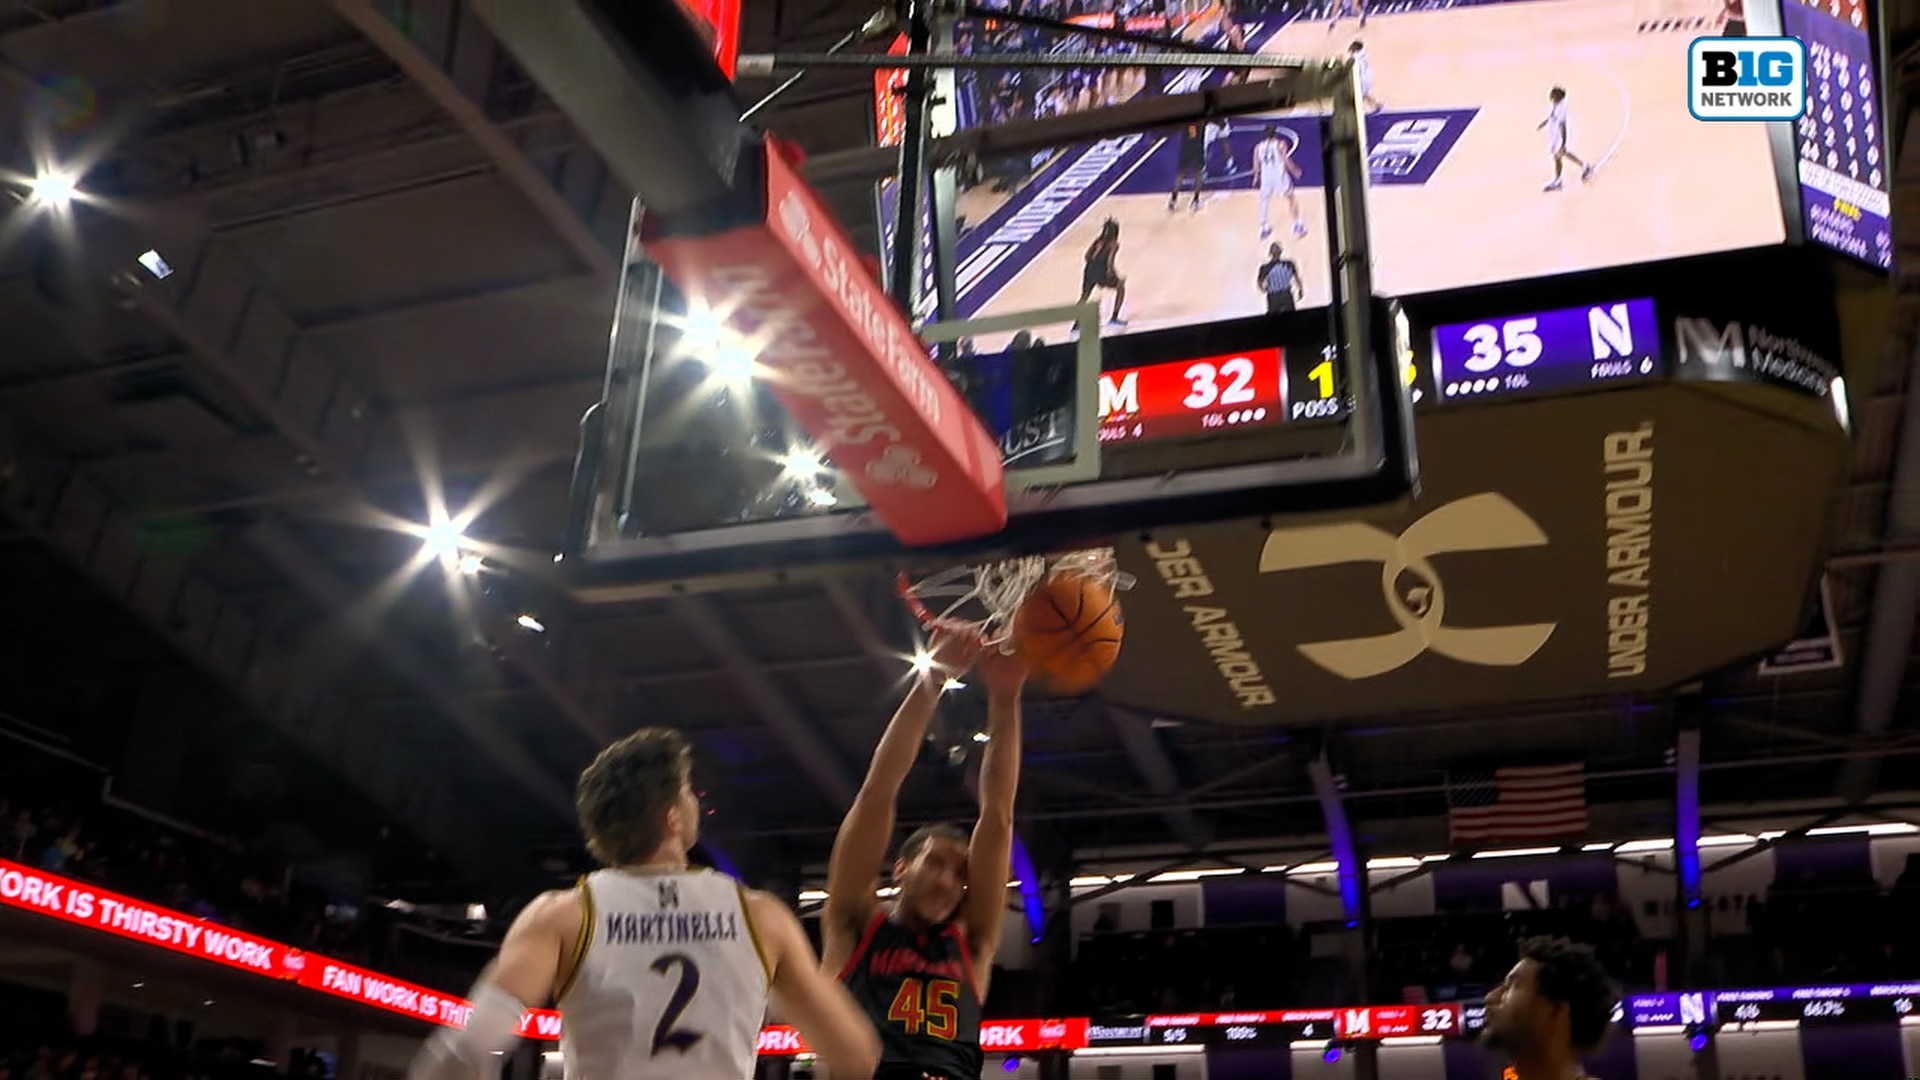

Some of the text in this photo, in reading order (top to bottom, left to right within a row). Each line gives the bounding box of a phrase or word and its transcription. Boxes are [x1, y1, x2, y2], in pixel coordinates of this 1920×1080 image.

[1463, 316, 1543, 373] 35
[1588, 303, 1633, 360] N
[1098, 371, 1140, 417] M
[1183, 357, 1256, 409] 32
[1182, 604, 1277, 708] ARMOUR
[1607, 594, 1650, 678] UNDER
[0, 867, 64, 911] ORK
[65, 889, 95, 918] IS
[98, 898, 203, 948] THIRSTY
[203, 928, 274, 970] WORK
[606, 911, 737, 945] MARTINELLI
[321, 965, 362, 996] FAN
[363, 976, 419, 1013] WORK
[418, 993, 439, 1017] IS
[650, 952, 704, 1057] 2
[887, 977, 961, 1041] 45
[1421, 1008, 1453, 1031] 32
[1680, 992, 1705, 1025] N
